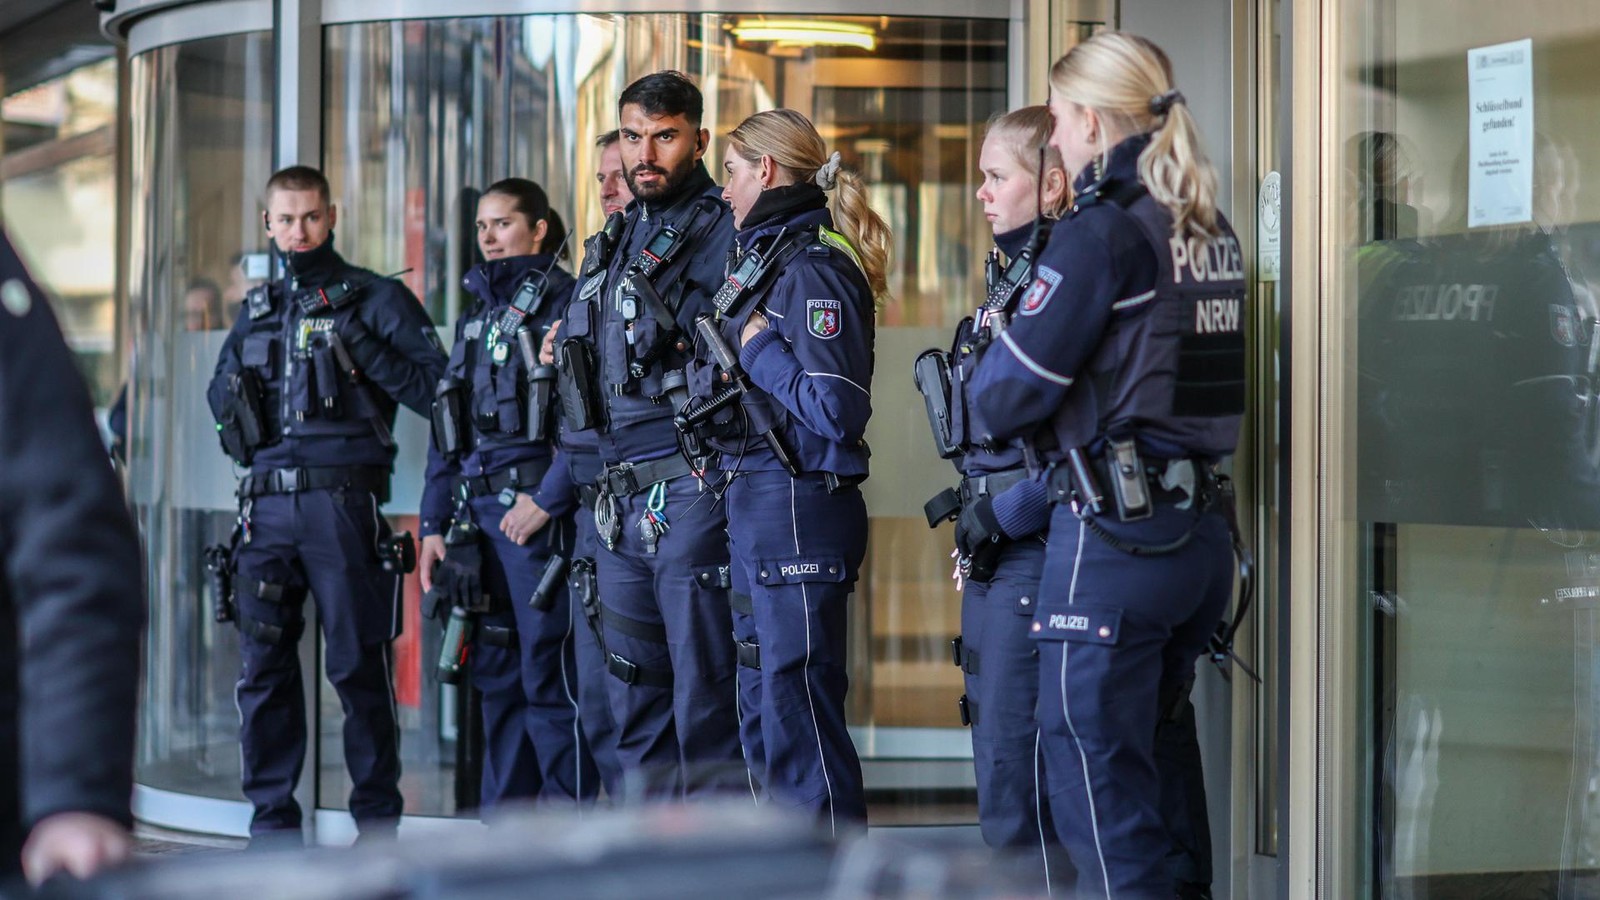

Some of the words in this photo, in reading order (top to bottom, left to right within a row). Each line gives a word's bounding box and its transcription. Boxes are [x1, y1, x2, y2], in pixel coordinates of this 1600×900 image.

[1169, 237, 1244, 283] POLIZE
[1196, 299, 1239, 333] NRW
[781, 564, 819, 576] POLIZEI
[1049, 614, 1089, 631] POLIZEI
